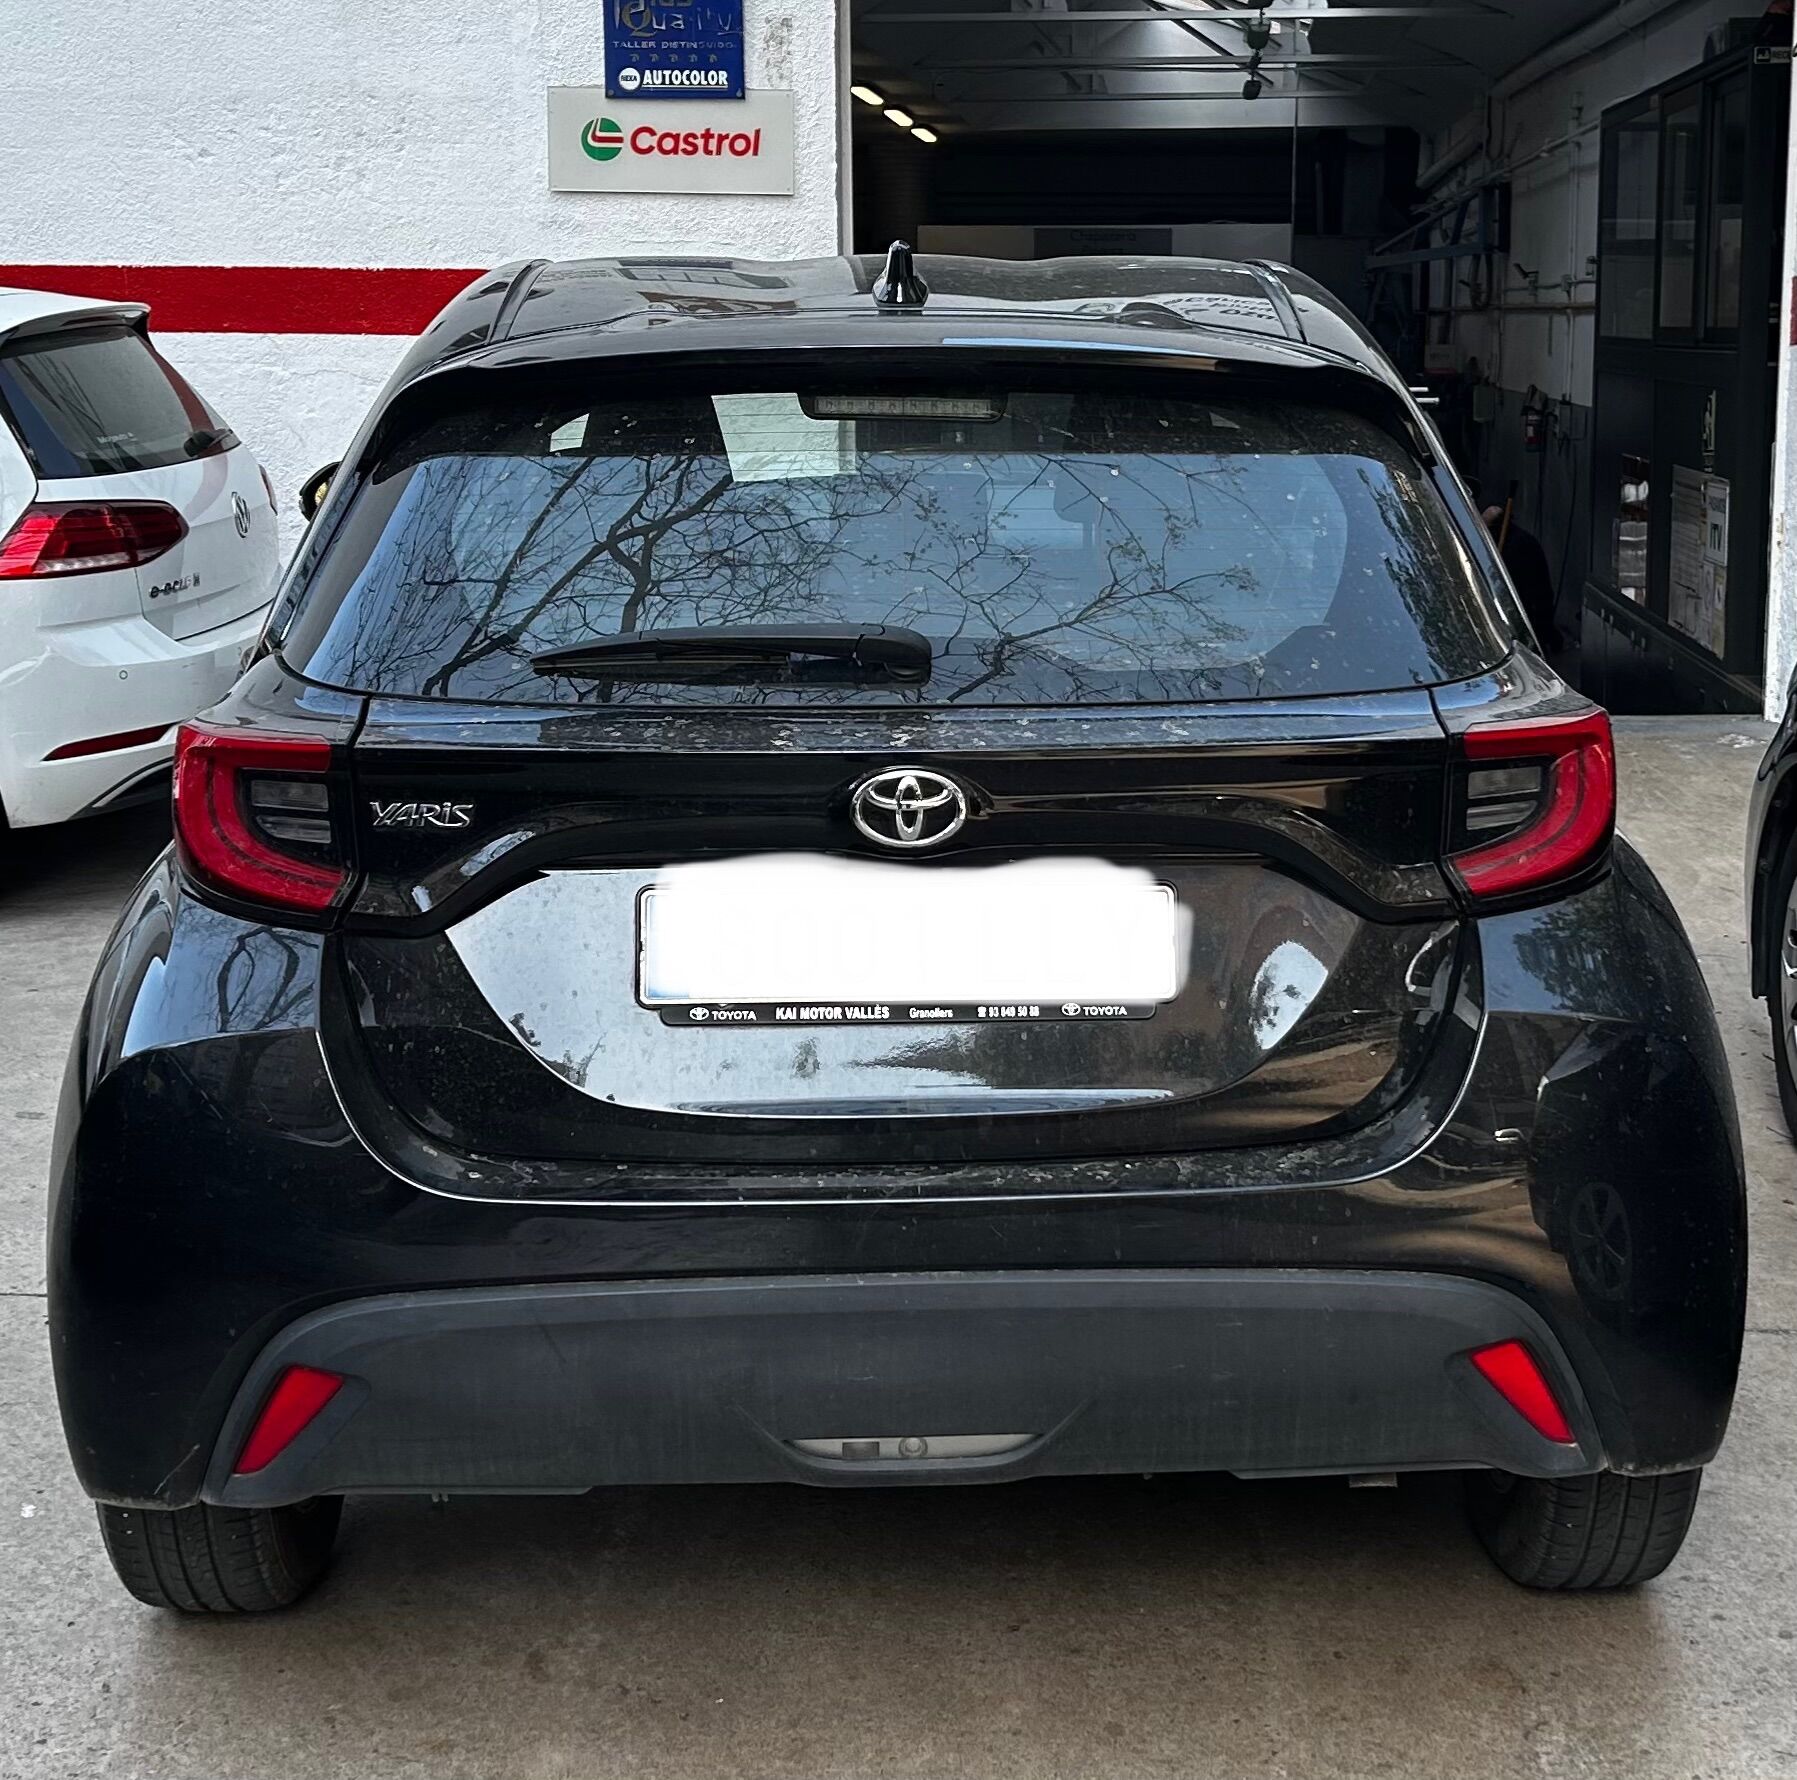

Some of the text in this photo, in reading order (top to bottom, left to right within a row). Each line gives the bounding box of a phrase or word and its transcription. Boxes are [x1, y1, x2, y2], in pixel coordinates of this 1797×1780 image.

[613, 41, 656, 49] TALLER
[642, 70, 728, 85] AUTOCOLOR
[630, 127, 761, 156] Castrol
[712, 1010, 757, 1020] TOYOTA
[776, 1007, 797, 1020] KAI
[800, 1006, 842, 1020] MOTOR
[909, 1007, 954, 1019] Granollers
[1083, 1006, 1127, 1016] TOYOTA
